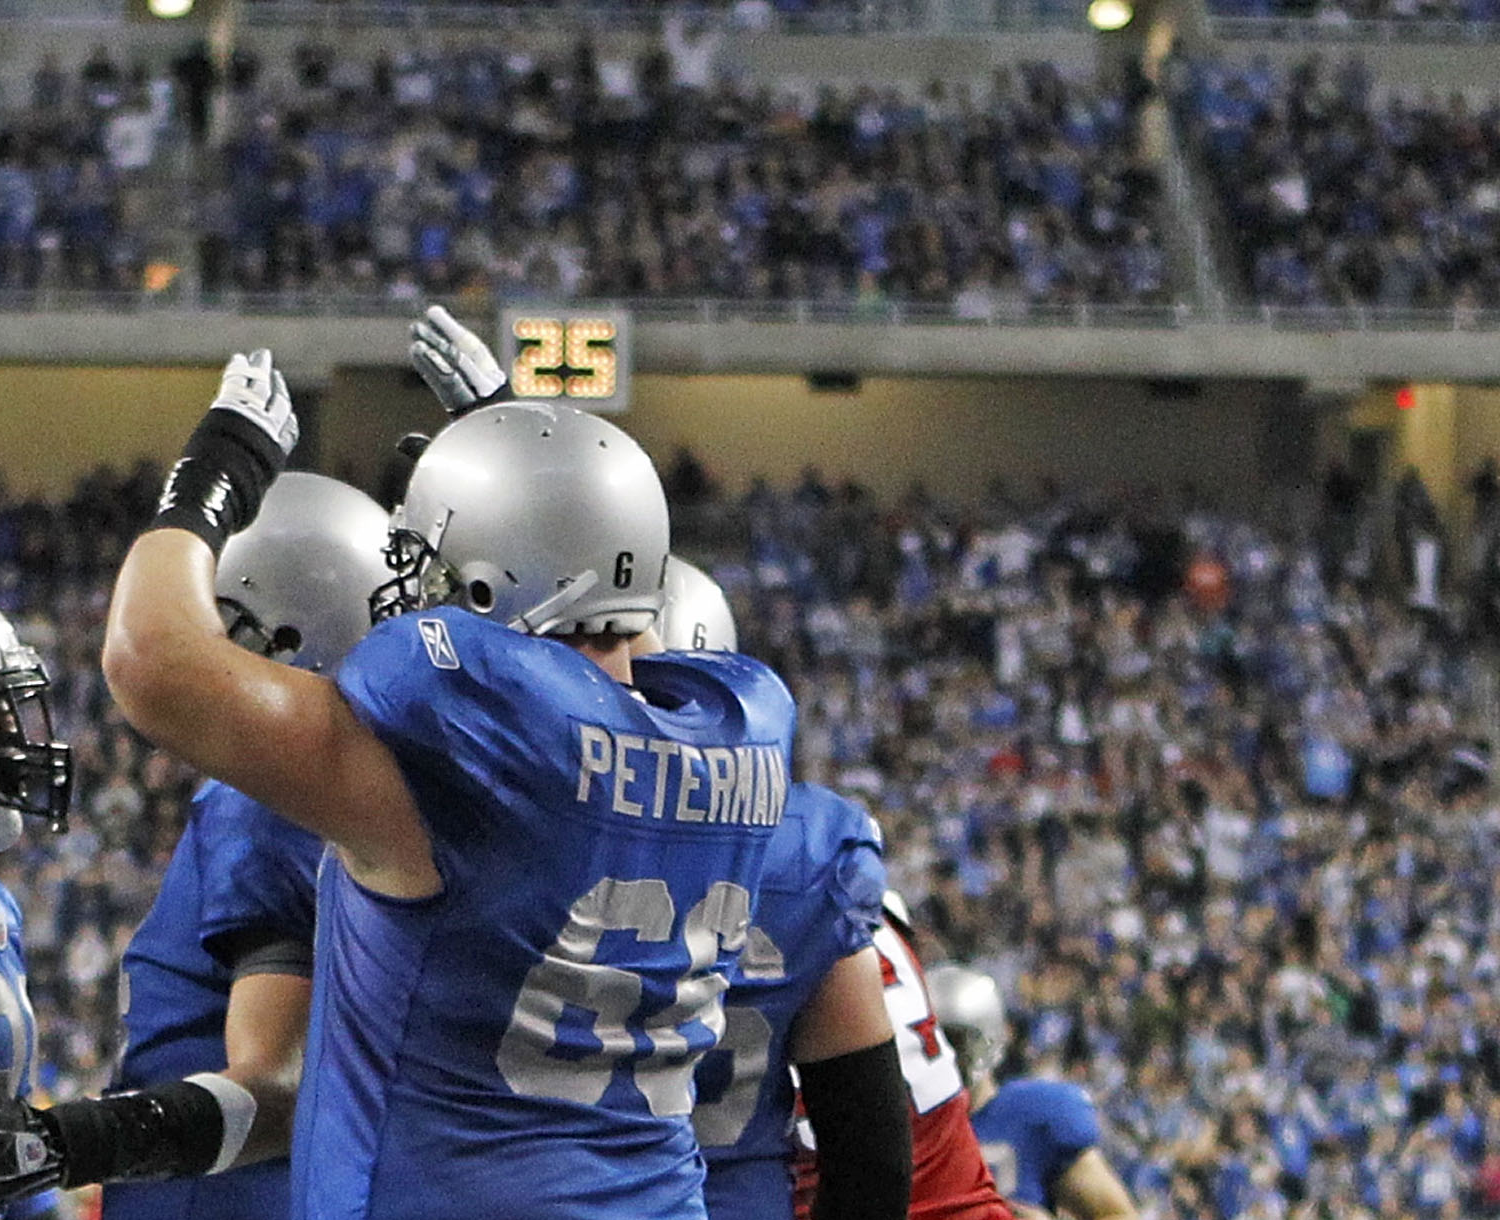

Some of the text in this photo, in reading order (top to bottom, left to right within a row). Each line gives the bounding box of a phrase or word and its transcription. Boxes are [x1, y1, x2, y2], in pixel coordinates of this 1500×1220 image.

[512, 318, 616, 397] 25
[577, 724, 787, 826] PETERMAN
[497, 877, 749, 1117] 66
